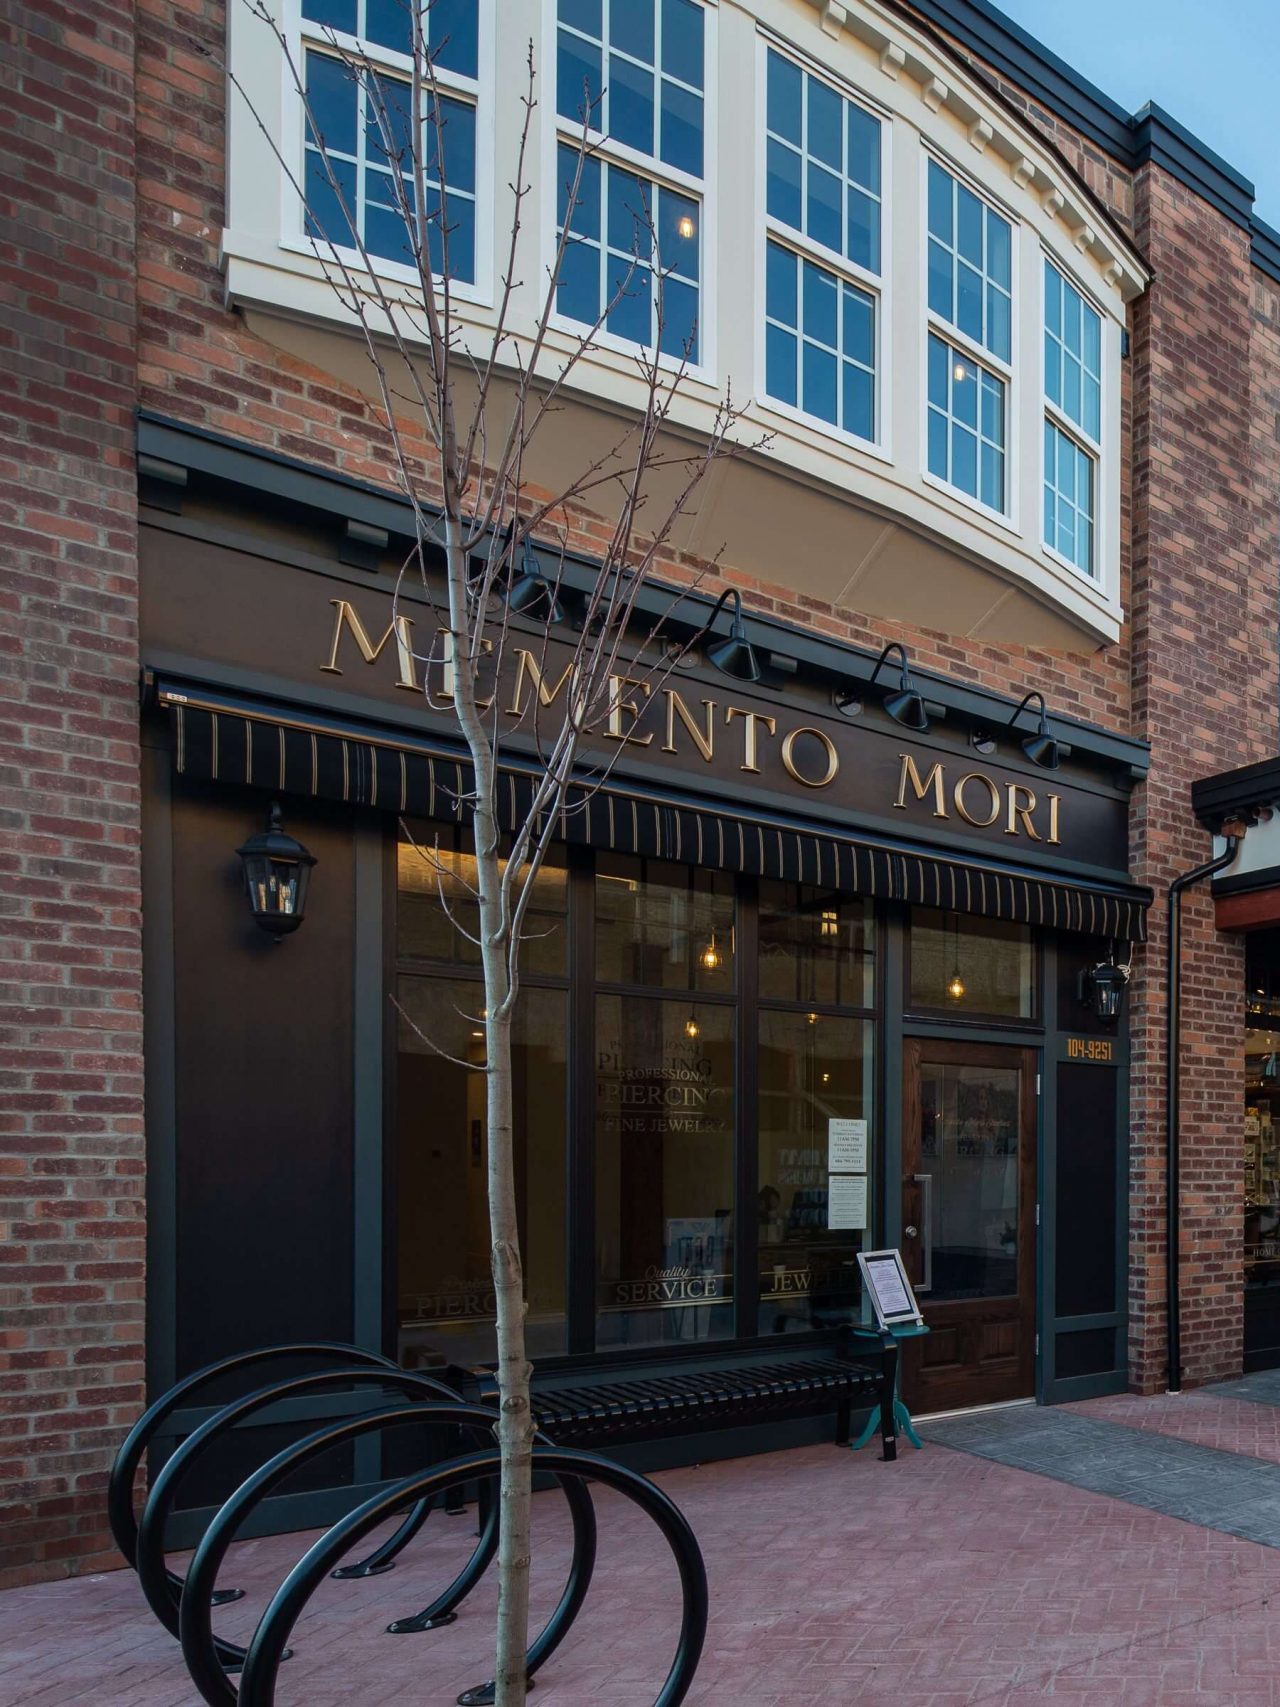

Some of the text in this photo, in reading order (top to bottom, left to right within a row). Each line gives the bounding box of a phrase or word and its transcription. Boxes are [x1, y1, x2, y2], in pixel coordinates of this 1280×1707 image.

[319, 598, 1063, 846] MEMENTO MORI
[1068, 1037, 1112, 1061] 104-9251
[618, 1067, 717, 1086] PROFESSIONAL
[605, 1117, 727, 1134] FINE JEWELRY
[1253, 1247, 1275, 1257] HOME
[645, 1264, 692, 1282] Quality
[616, 1279, 718, 1303] SERVICE
